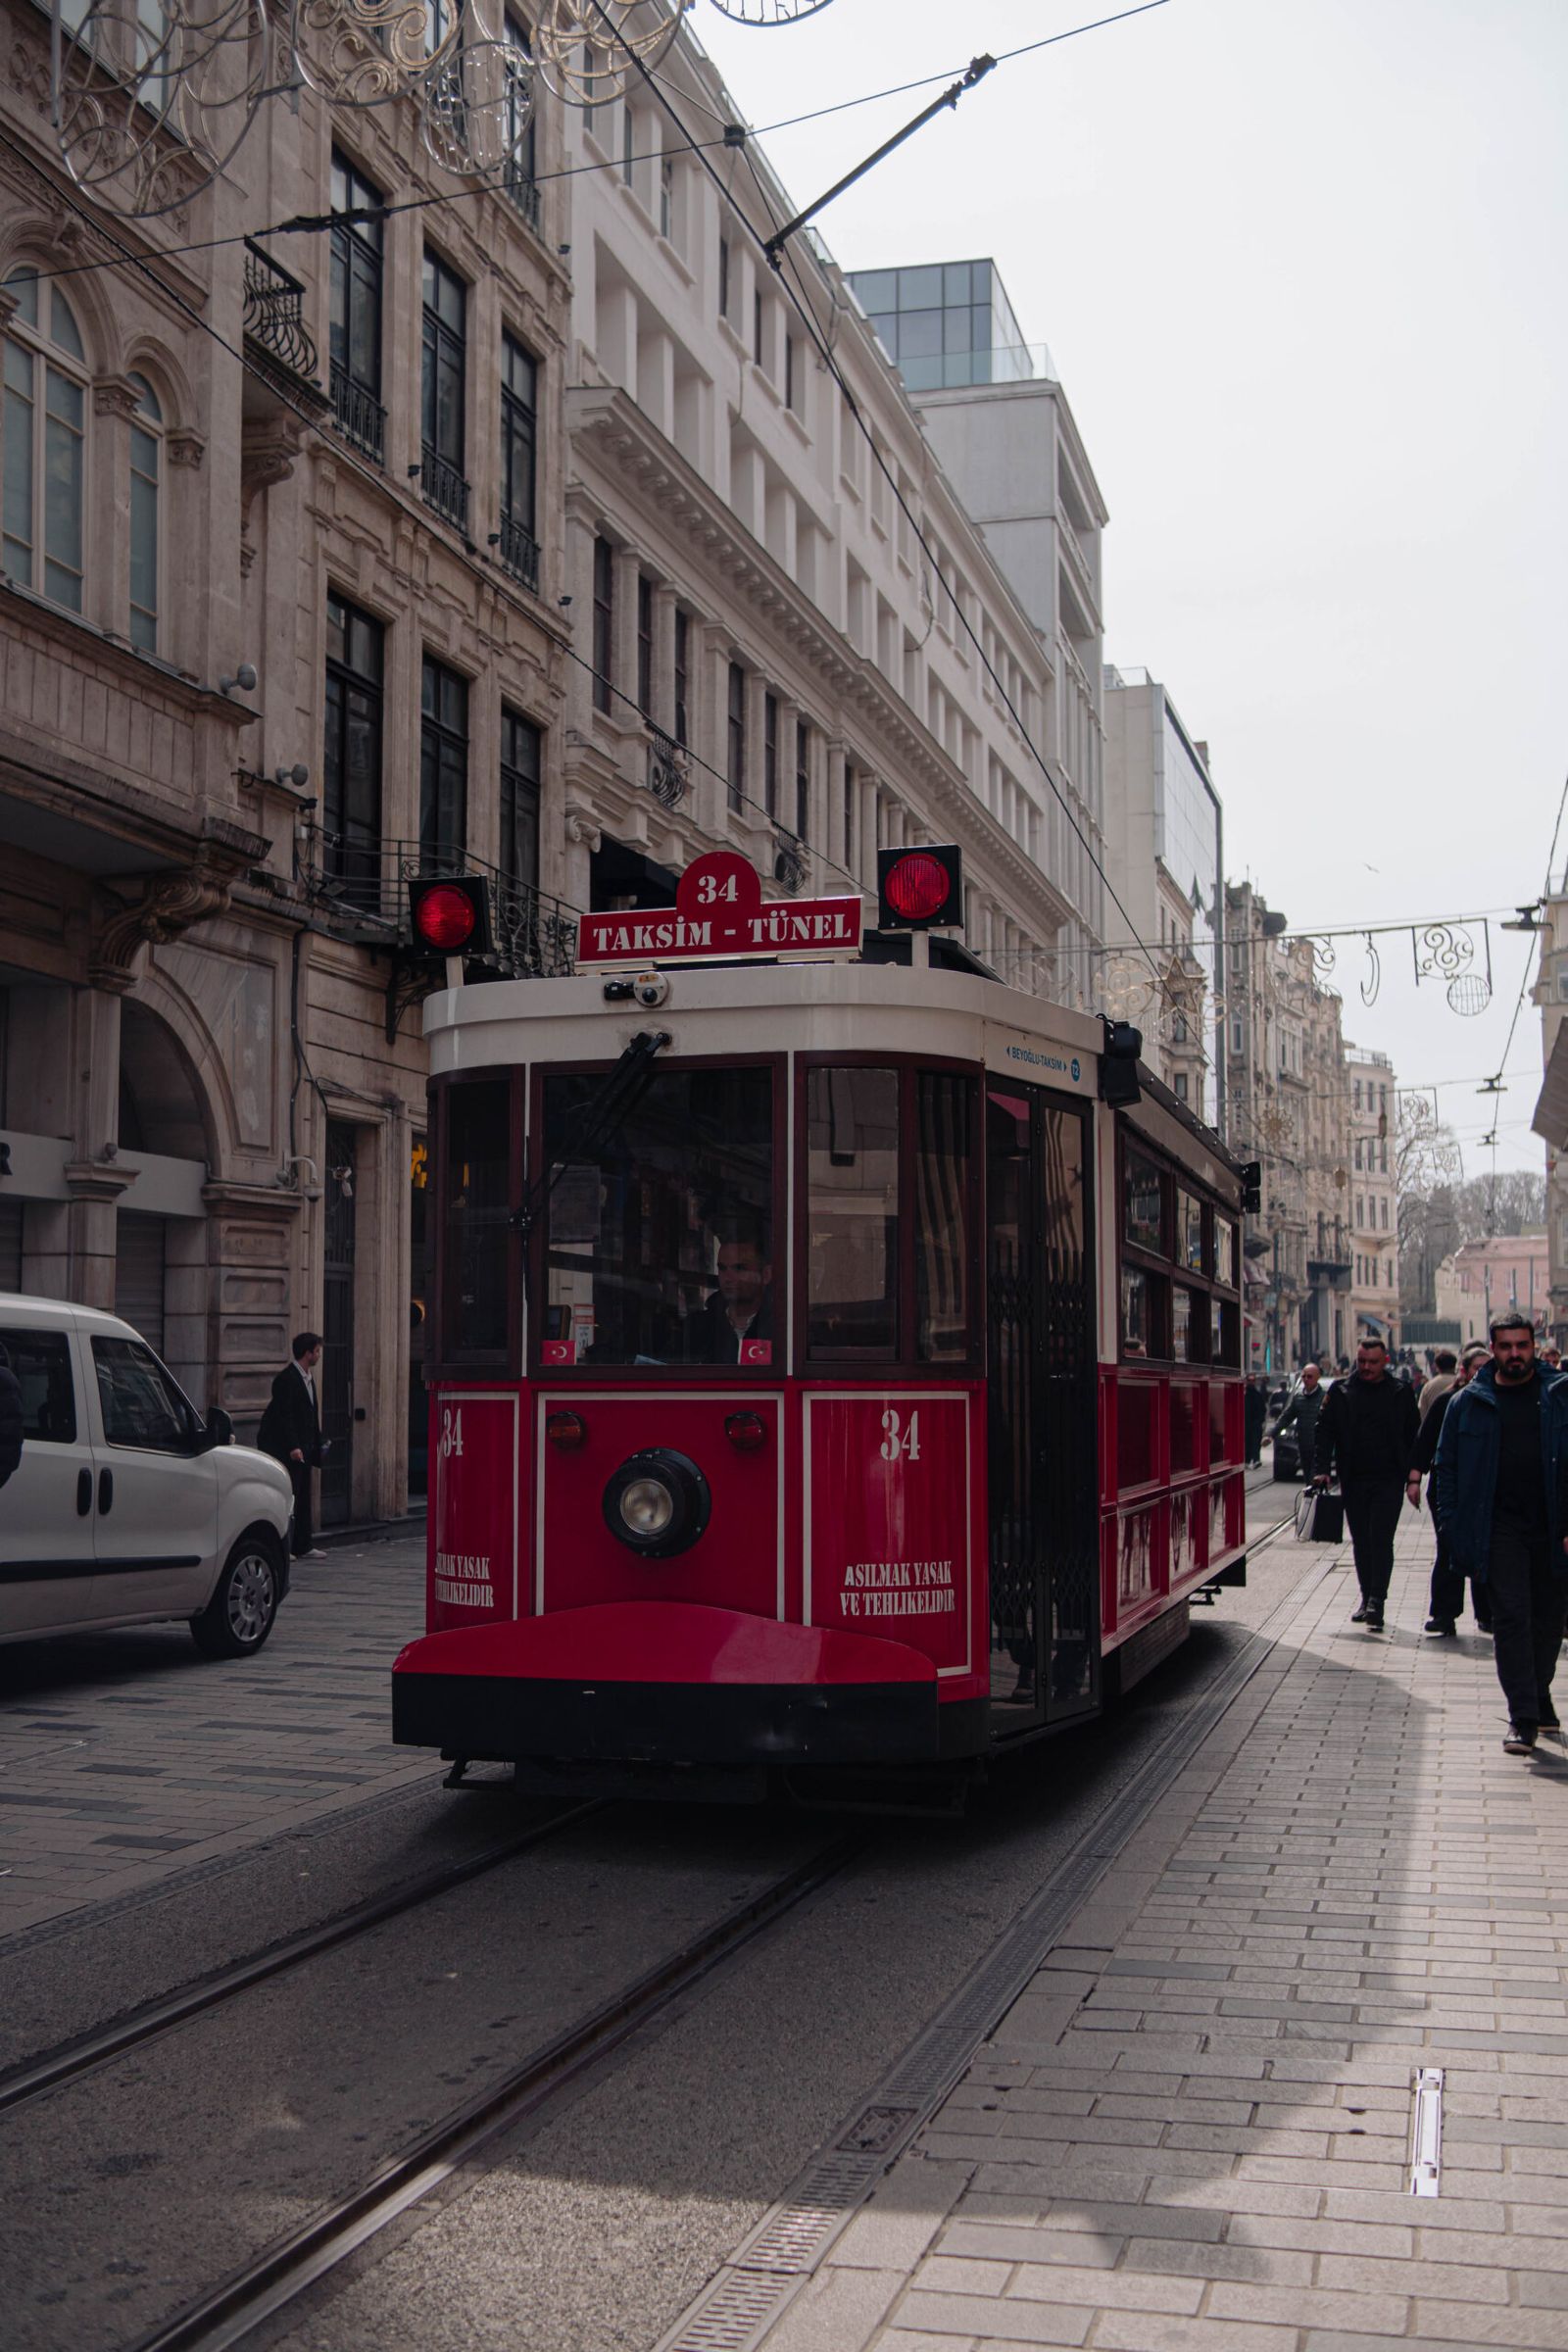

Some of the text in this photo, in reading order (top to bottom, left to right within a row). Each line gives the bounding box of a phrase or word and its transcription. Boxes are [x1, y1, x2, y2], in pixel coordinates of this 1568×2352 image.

[697, 874, 739, 904] 34
[593, 915, 712, 952] TAKSİM
[748, 909, 852, 943] TÜNEL
[443, 1407, 464, 1458] 34
[880, 1409, 921, 1461] 34
[457, 1554, 491, 1580] YASAK
[844, 1560, 953, 1588] ASILMAK YASAK
[840, 1589, 956, 1616] VE TEHLIKELIDIR
